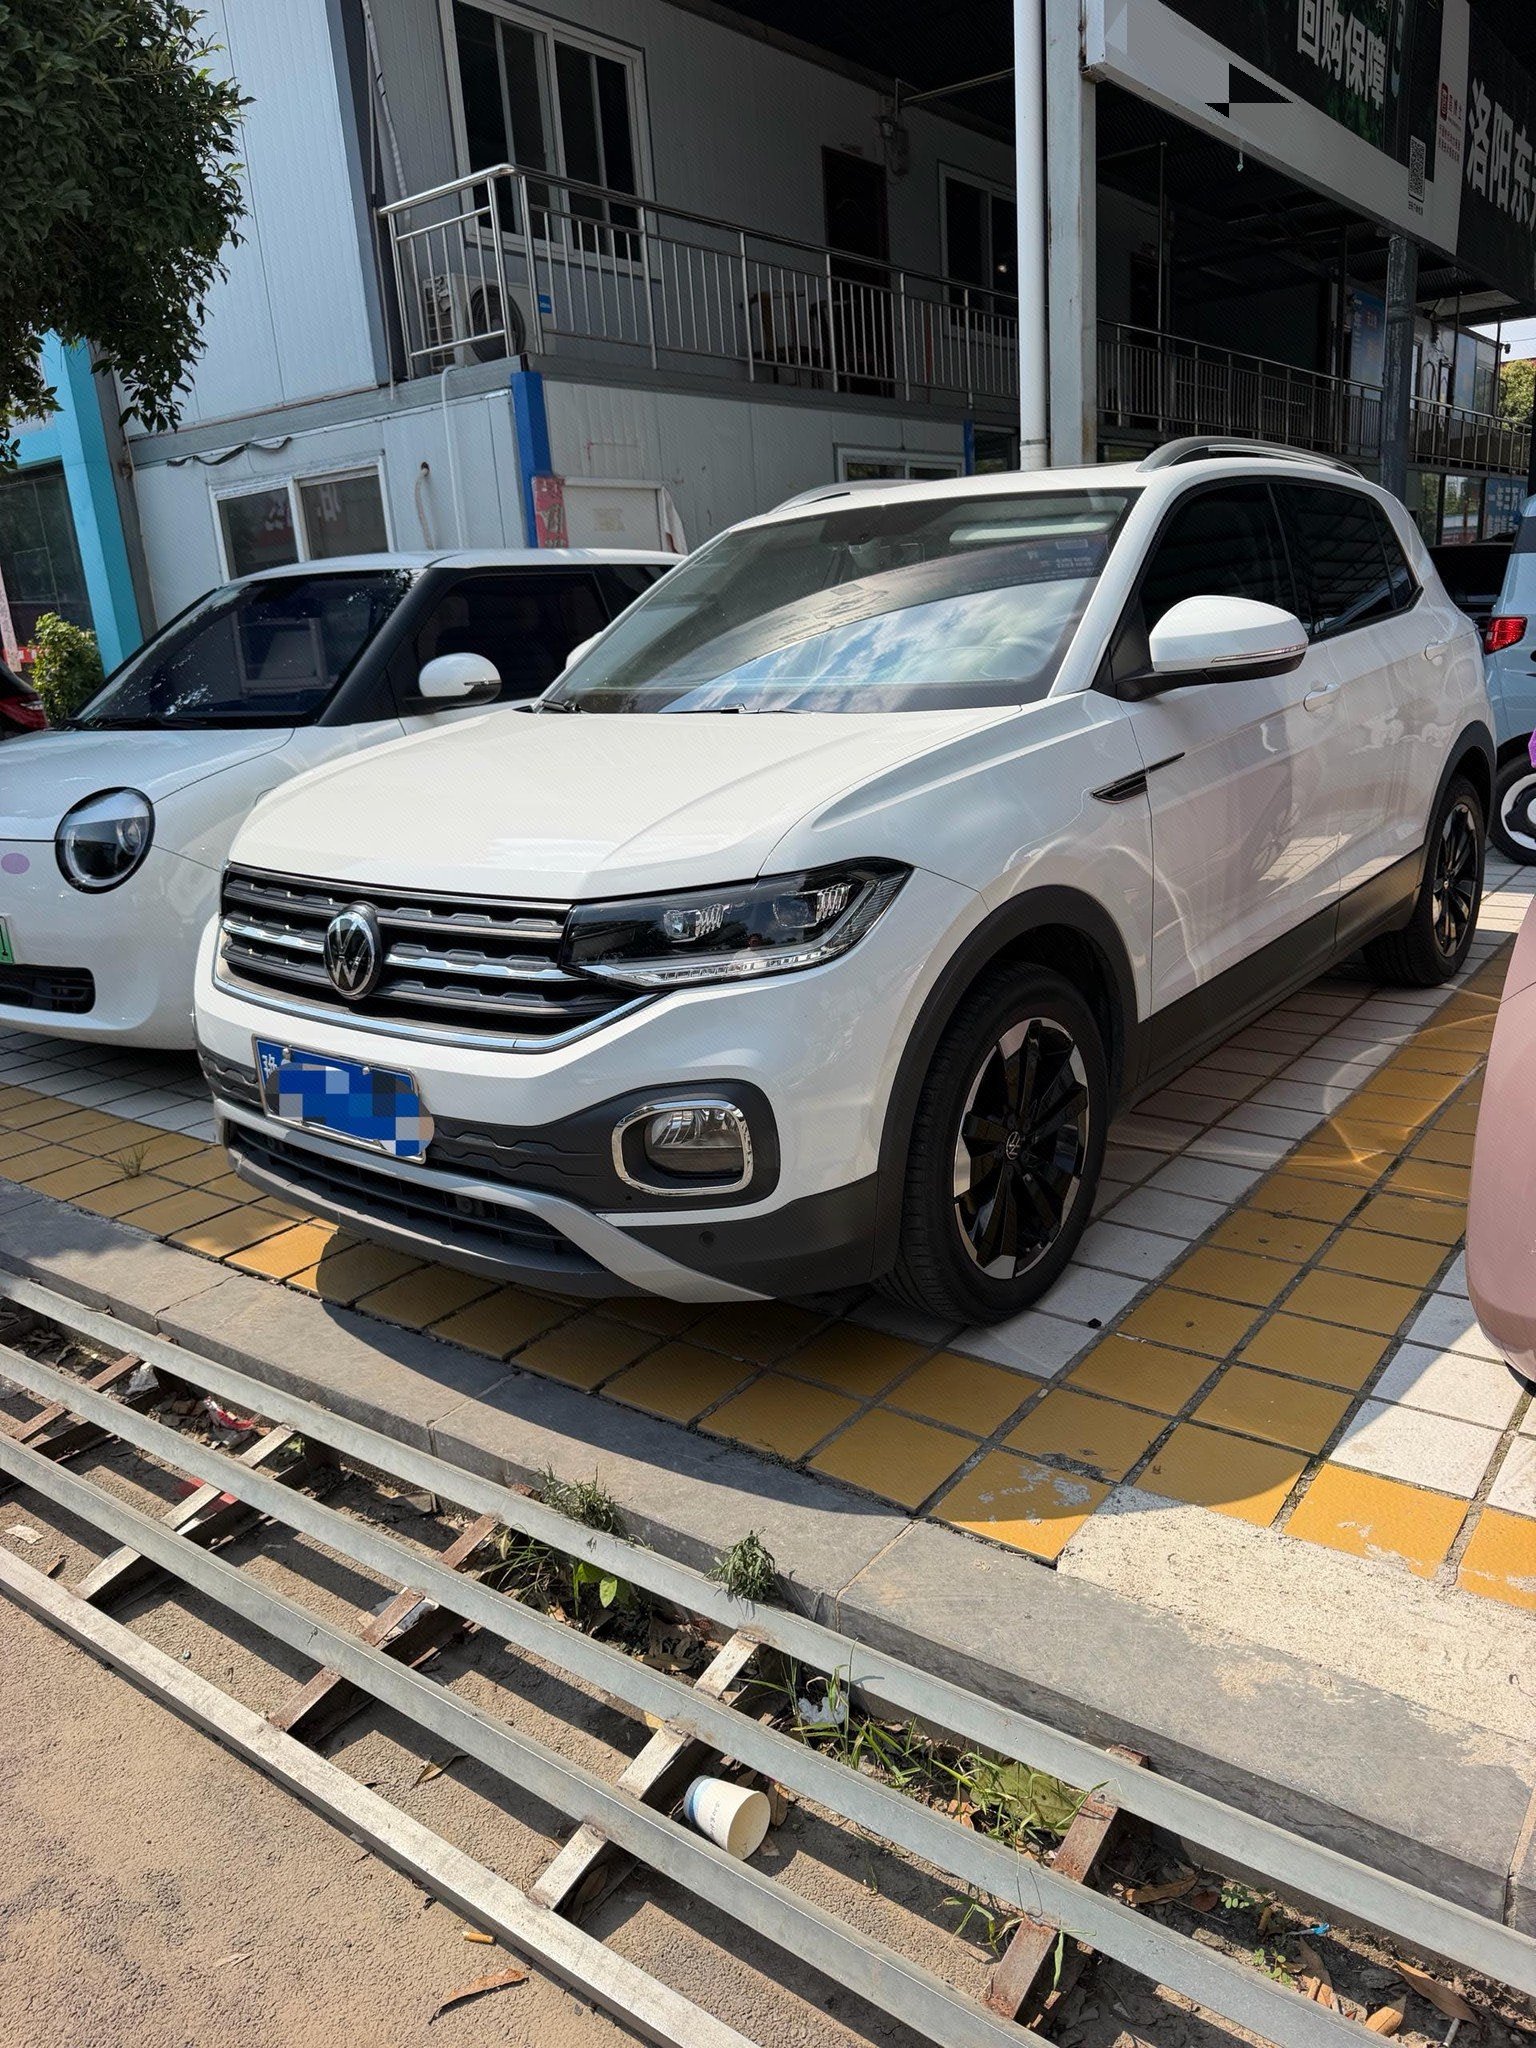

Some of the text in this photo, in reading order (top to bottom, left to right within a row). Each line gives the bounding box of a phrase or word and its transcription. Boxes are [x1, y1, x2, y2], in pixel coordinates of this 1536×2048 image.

[1297, 0, 1386, 111] 回购保障
[1467, 78, 1536, 231] 洛阳东
